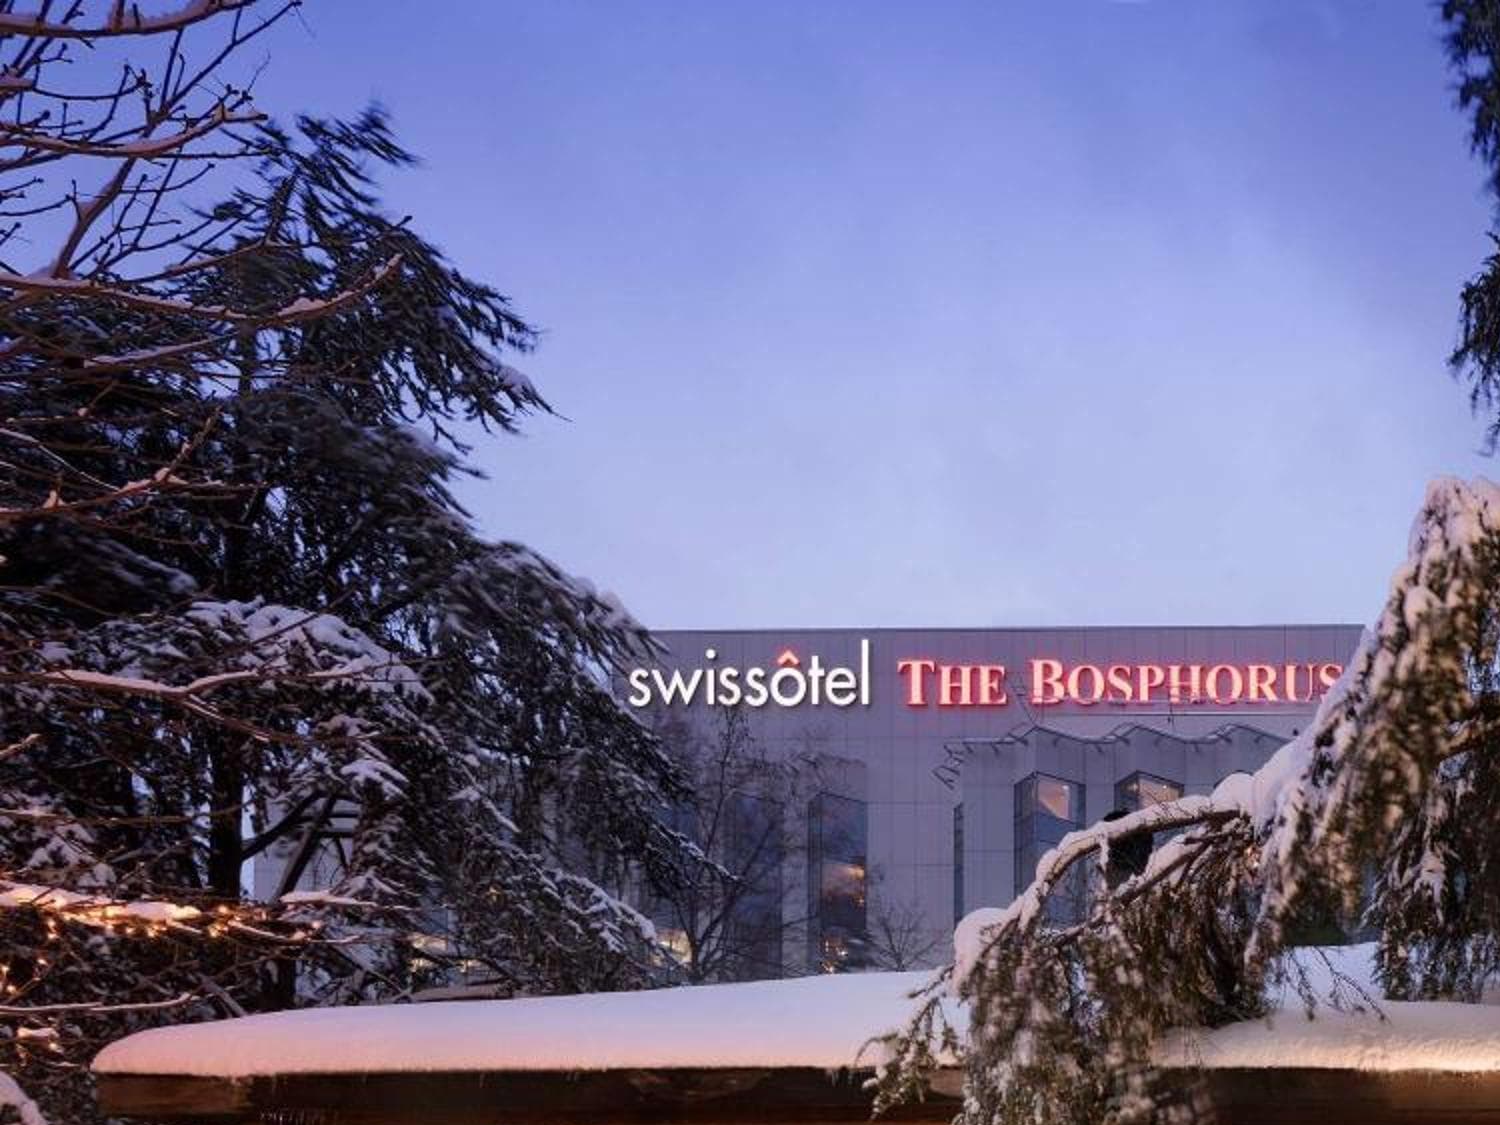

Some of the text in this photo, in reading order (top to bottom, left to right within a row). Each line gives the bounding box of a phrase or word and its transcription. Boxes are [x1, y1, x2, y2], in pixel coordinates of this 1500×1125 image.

[629, 639, 1343, 706] swissôtel THE BOSPHORUS
